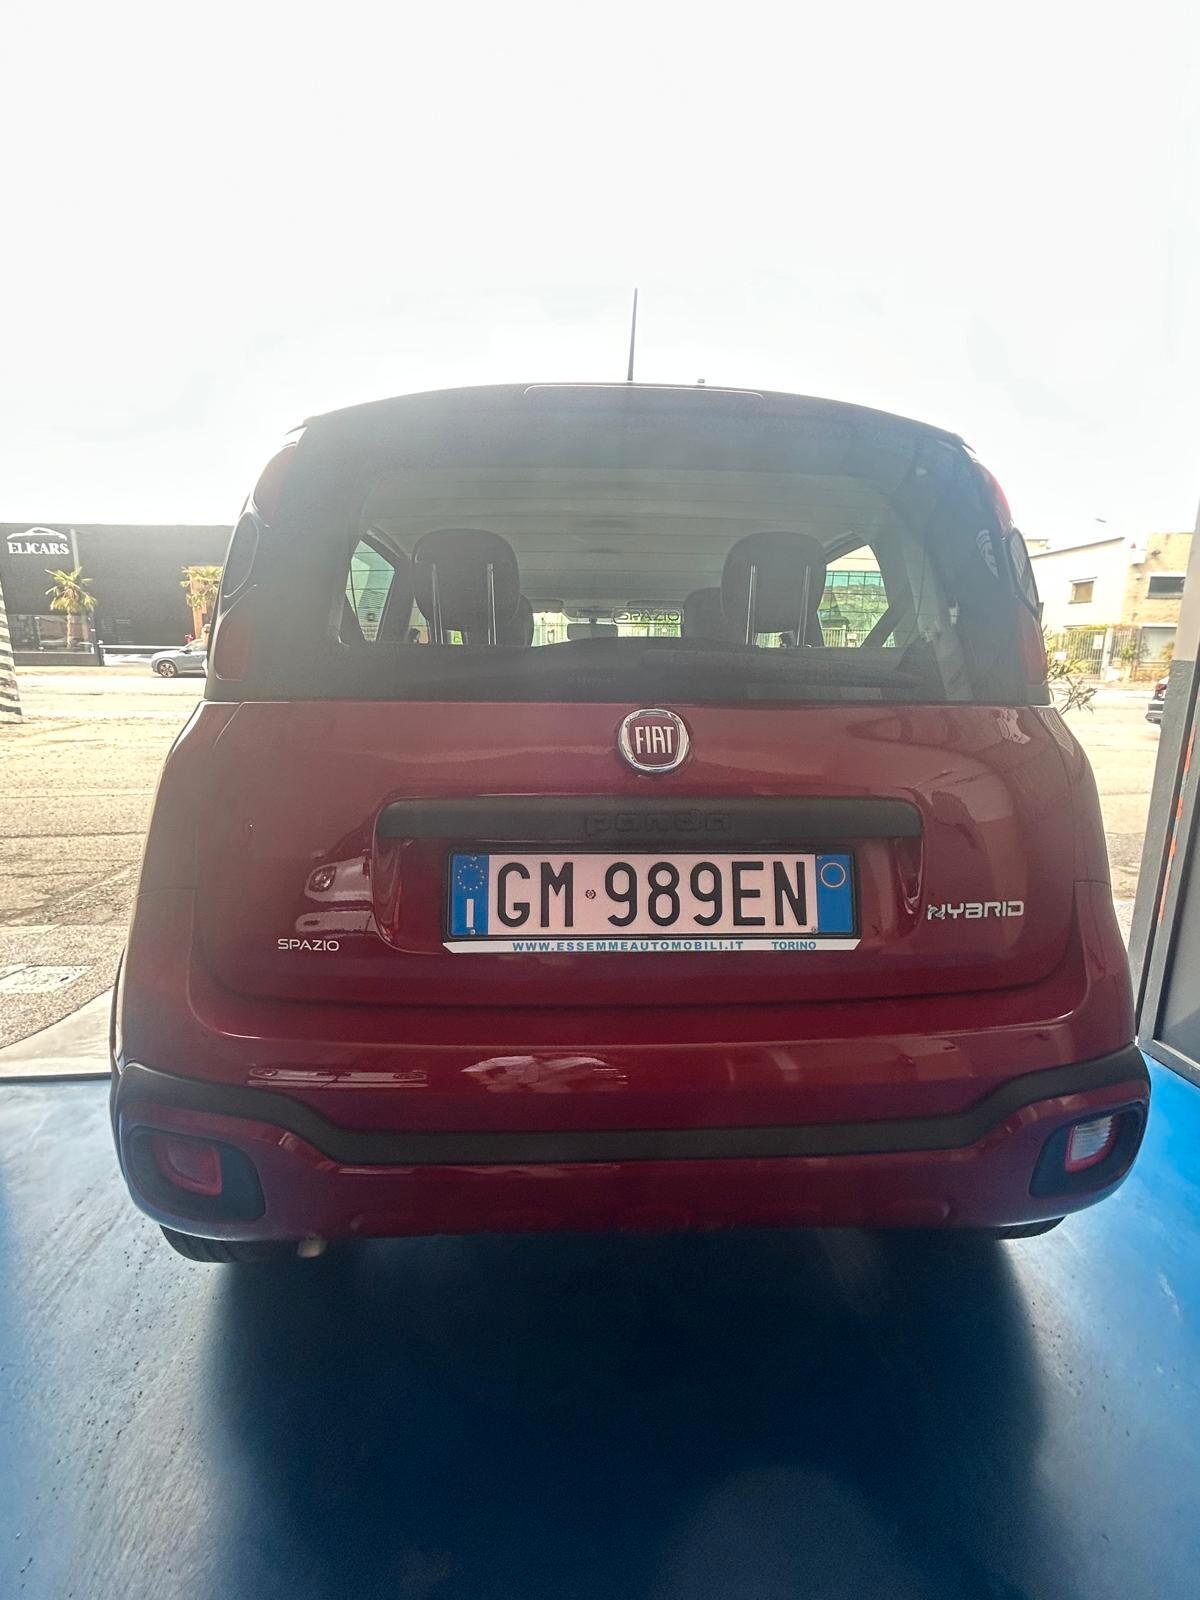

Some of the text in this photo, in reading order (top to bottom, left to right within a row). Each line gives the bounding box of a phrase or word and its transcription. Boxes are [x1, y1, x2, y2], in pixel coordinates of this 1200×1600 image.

[7, 541, 70, 555] ELICARS
[616, 609, 681, 622] SPAZIO
[634, 726, 674, 754] FIAT
[497, 860, 808, 928] GM 989EN
[927, 900, 1025, 920] HYBRID
[277, 938, 340, 952] SPAZIO
[512, 940, 817, 952] WWW.ESSEMMEAUTOMOBILI.IT TORINO
